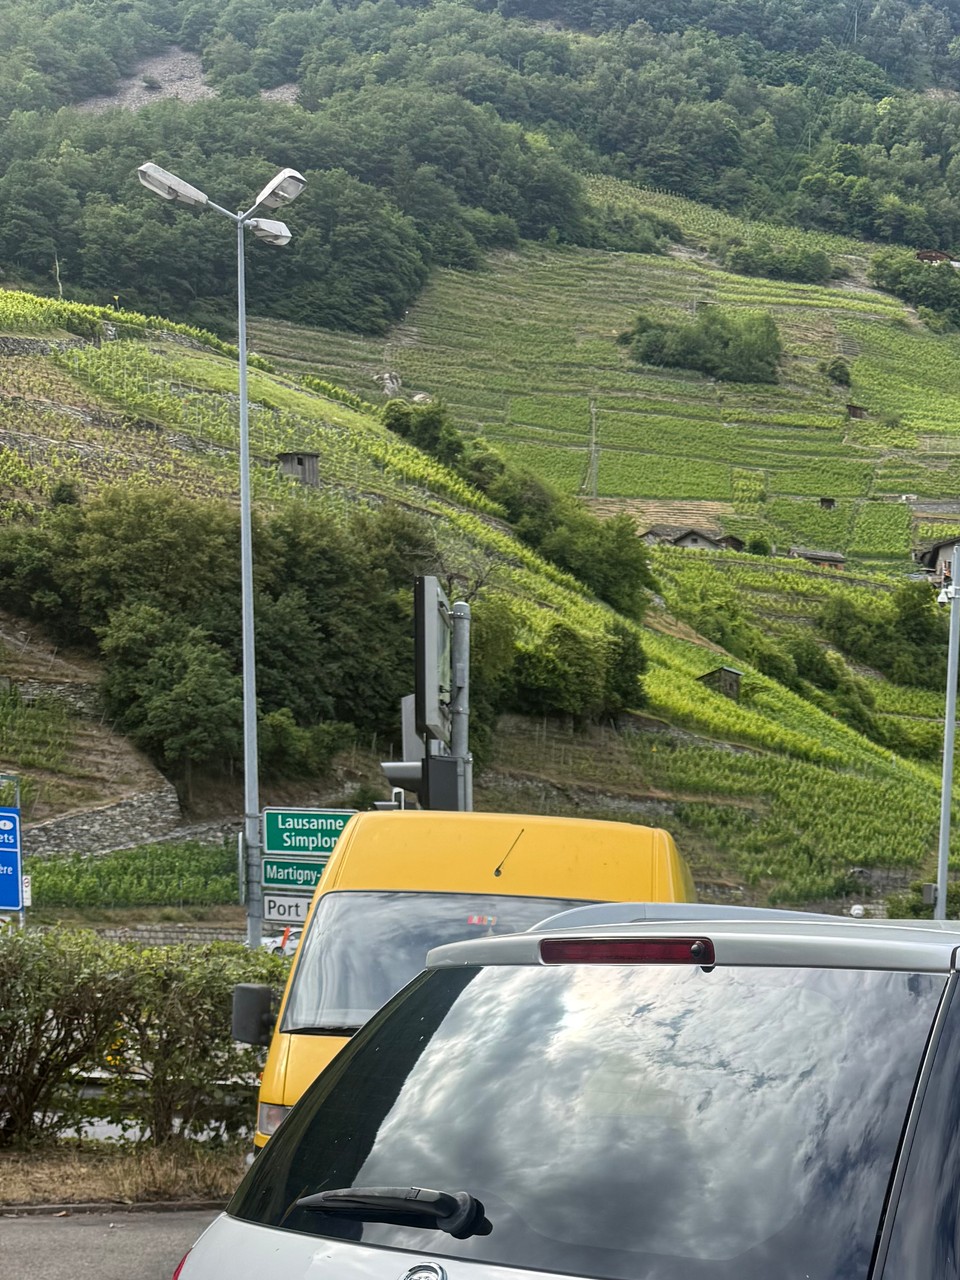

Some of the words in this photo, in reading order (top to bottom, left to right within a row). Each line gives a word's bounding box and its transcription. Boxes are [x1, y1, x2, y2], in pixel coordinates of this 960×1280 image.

[277, 815, 344, 831] Lausanne
[266, 864, 325, 885] Martigny-
[267, 899, 301, 917] Port
